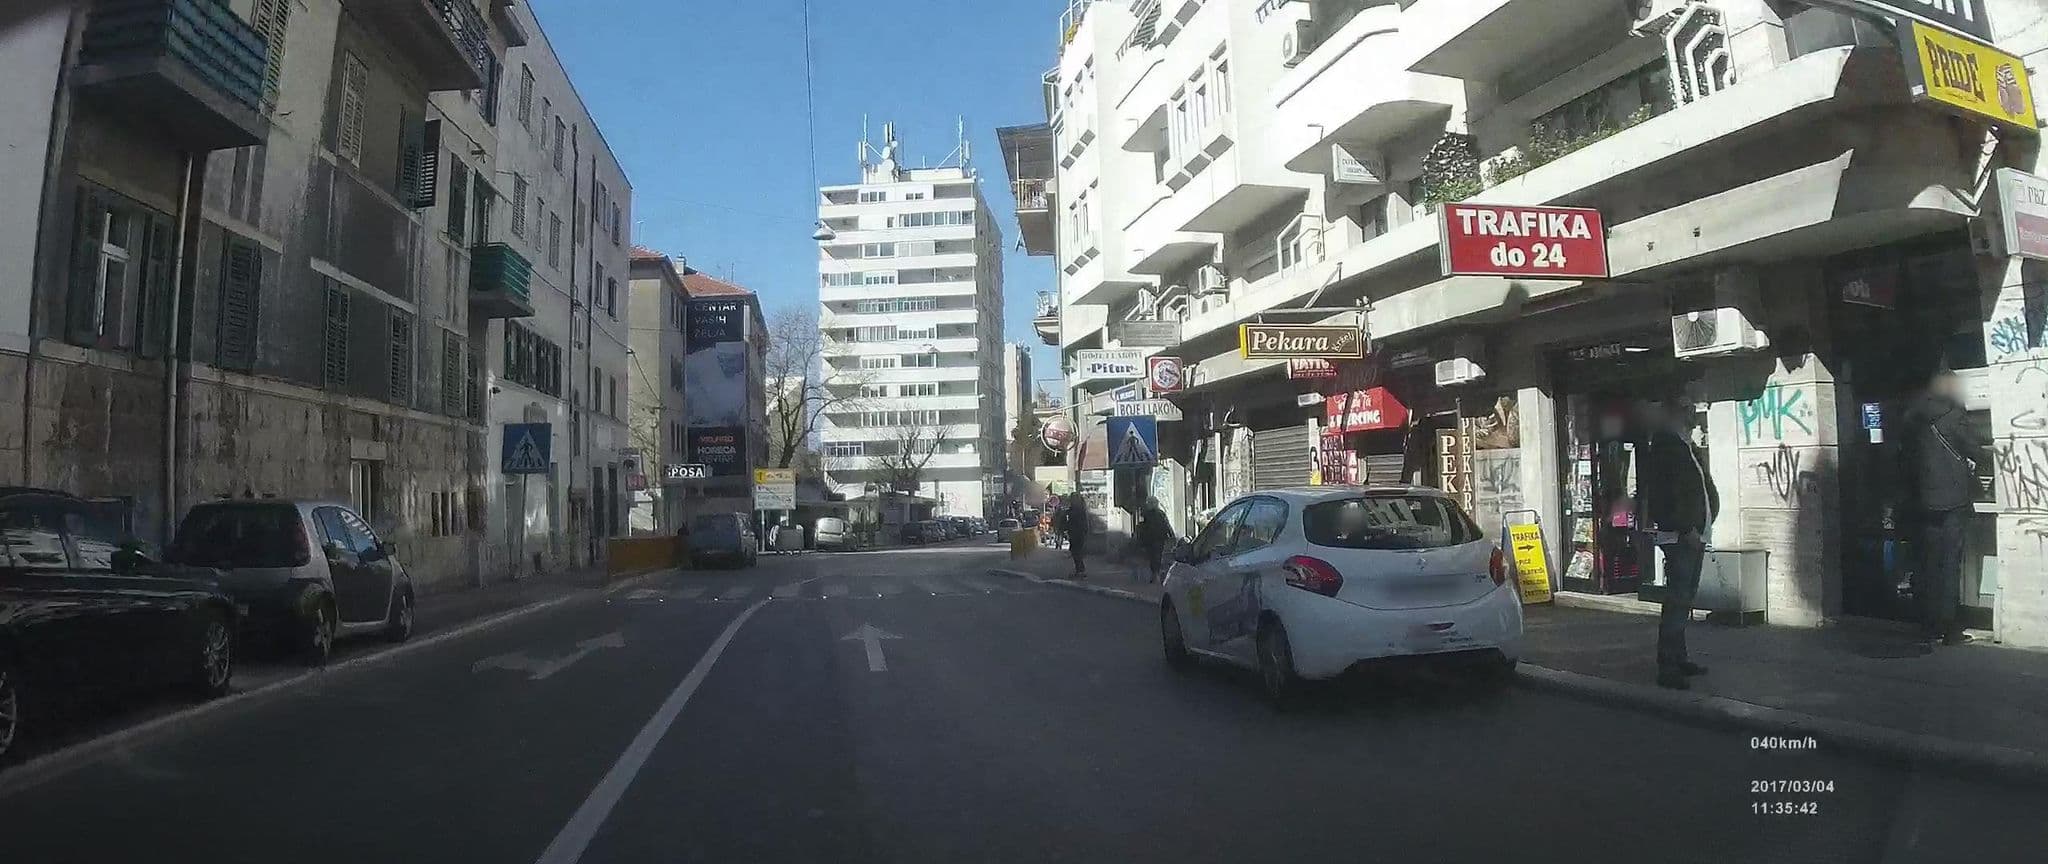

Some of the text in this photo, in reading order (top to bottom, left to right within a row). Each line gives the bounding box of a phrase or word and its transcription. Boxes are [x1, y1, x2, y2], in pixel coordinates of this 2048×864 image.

[1923, 35, 1986, 103] PRIDE
[1455, 208, 1592, 240] TRAFIKA
[1490, 241, 1567, 268] do 24
[694, 303, 737, 312] CENTAR
[1251, 331, 1329, 351] Pekara
[1119, 403, 1141, 415] BOJE
[1336, 409, 1380, 428] PERCING
[1461, 417, 1473, 516] PEKAR
